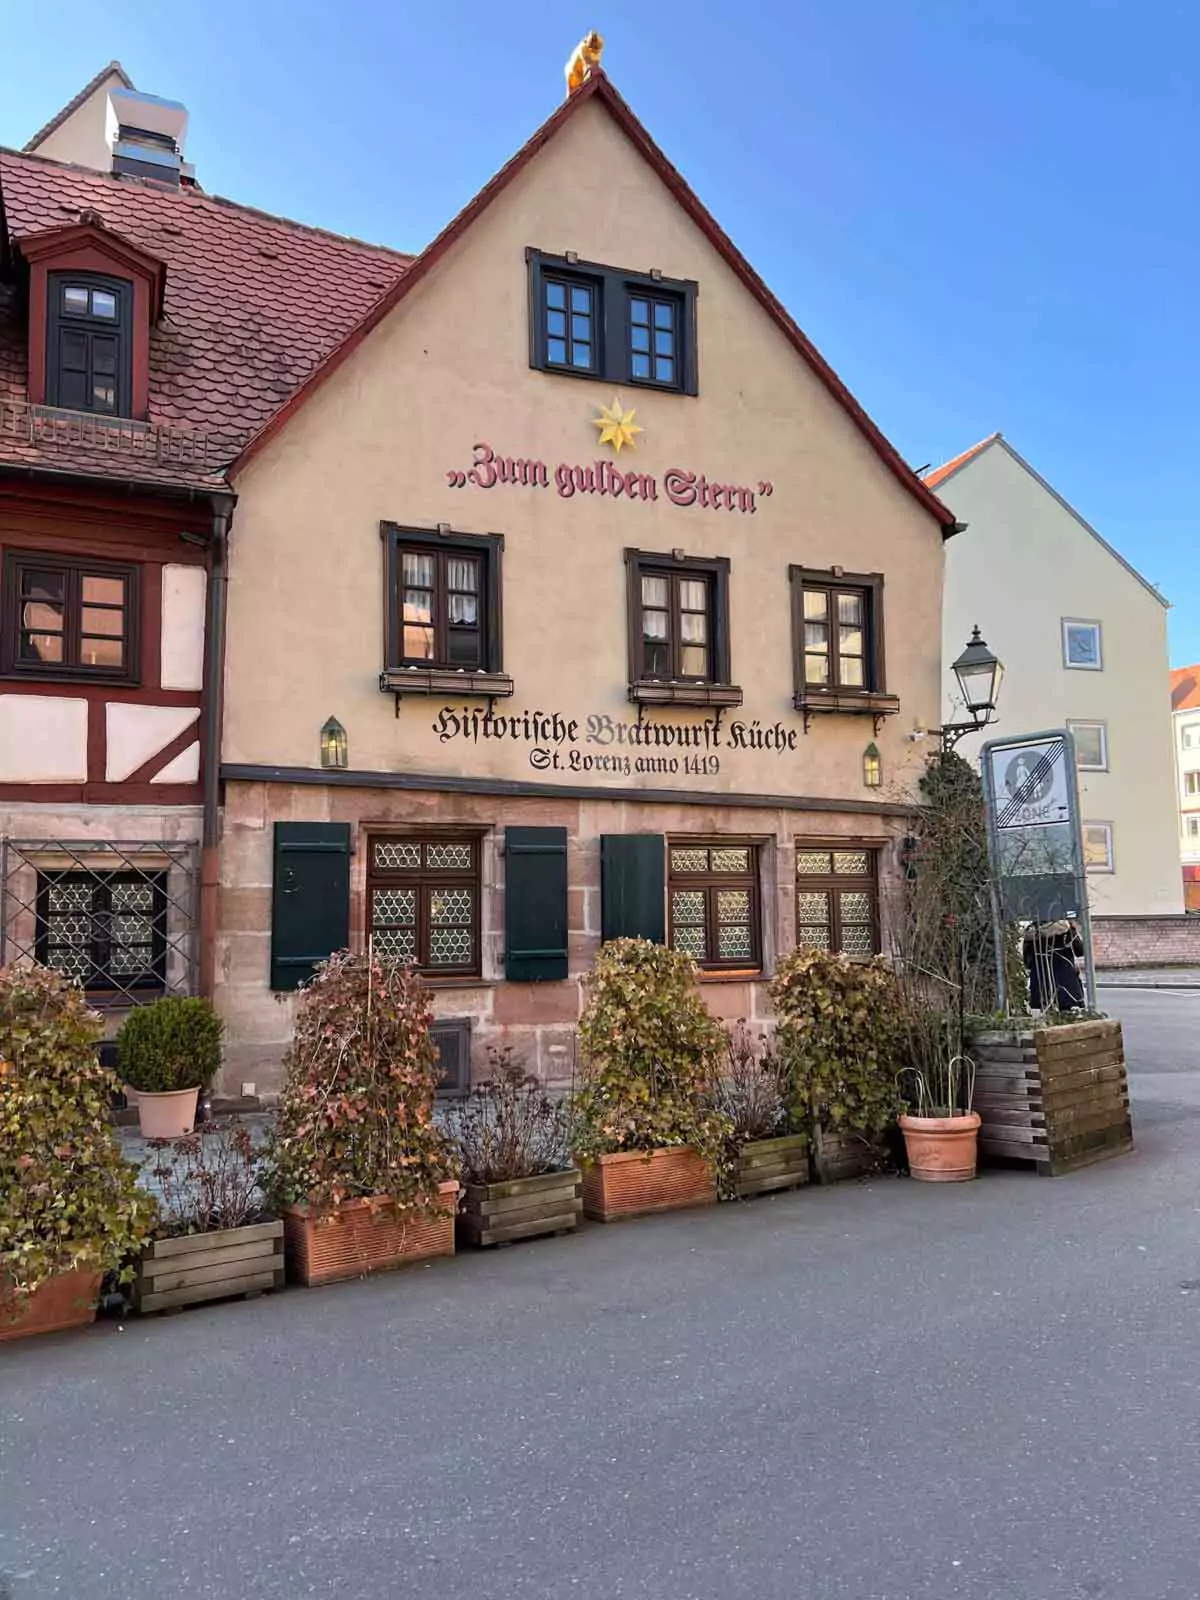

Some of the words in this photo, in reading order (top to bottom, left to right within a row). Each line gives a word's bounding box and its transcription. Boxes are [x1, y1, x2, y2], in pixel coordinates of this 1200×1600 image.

[432, 706, 579, 746] Historische
[585, 714, 721, 750] Bratwurst
[727, 719, 797, 754] Küche
[529, 748, 565, 771] St.
[568, 750, 631, 776] Lorenz
[635, 756, 679, 775] anno
[684, 753, 720, 775] 1419
